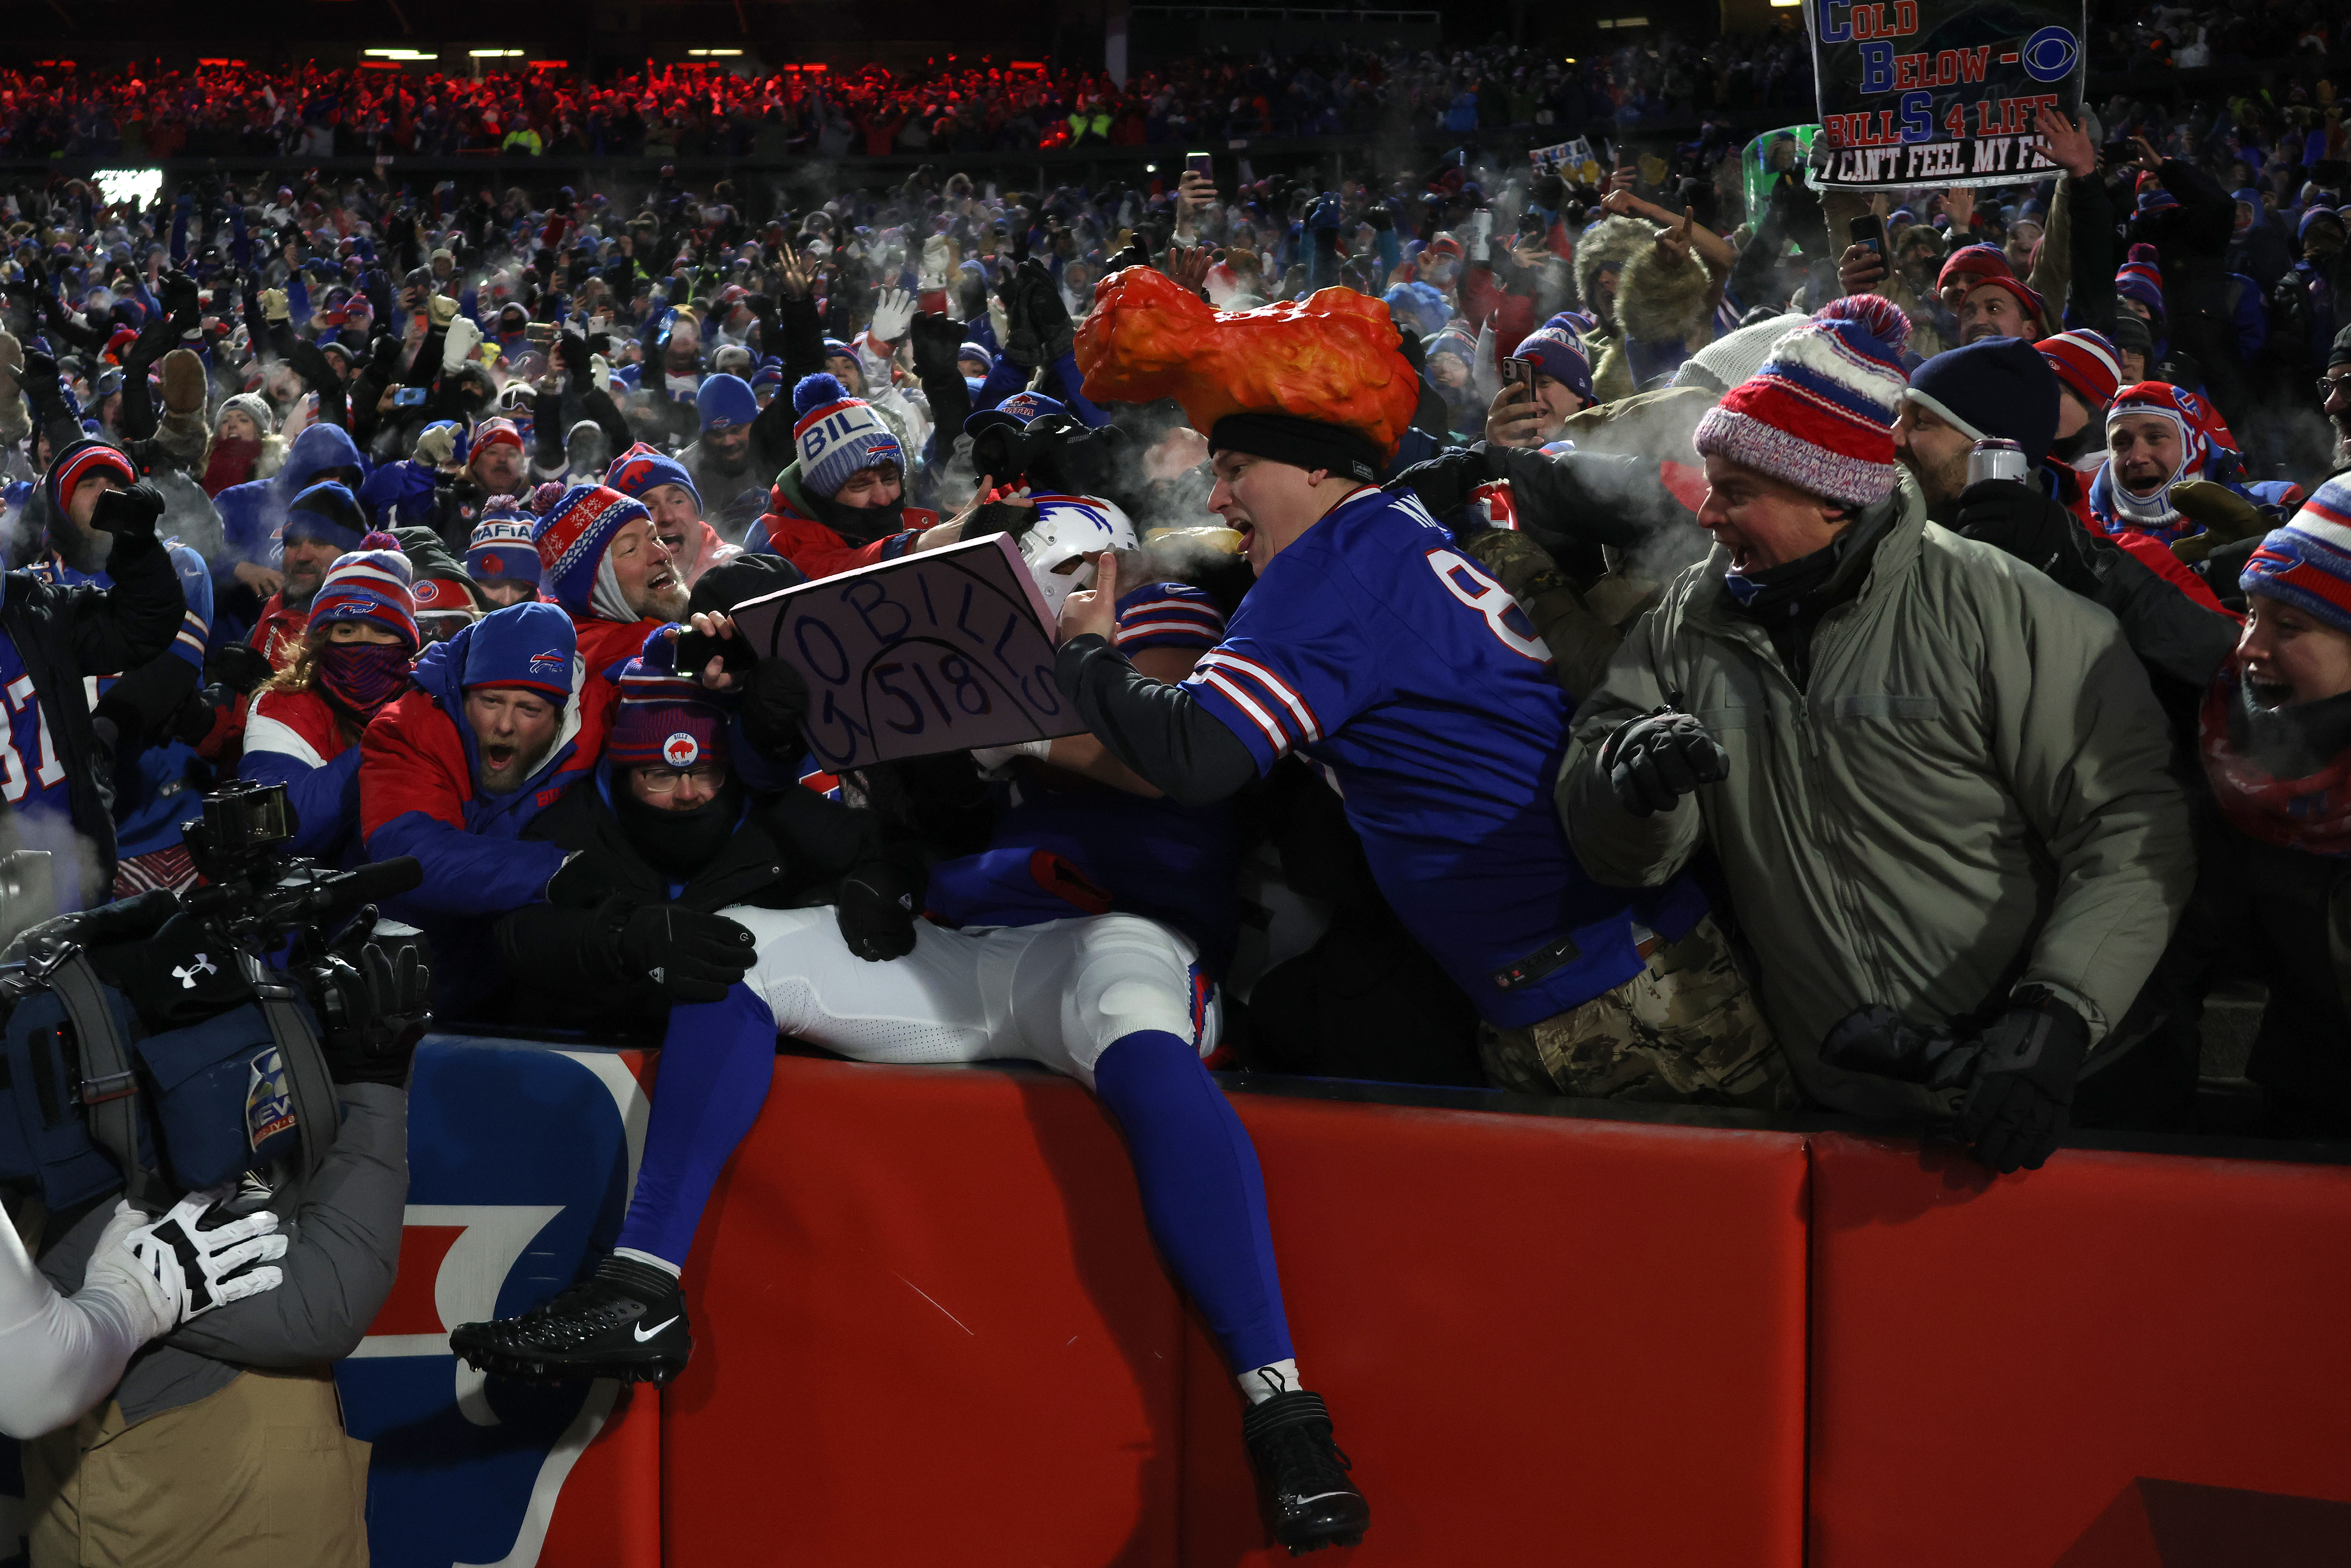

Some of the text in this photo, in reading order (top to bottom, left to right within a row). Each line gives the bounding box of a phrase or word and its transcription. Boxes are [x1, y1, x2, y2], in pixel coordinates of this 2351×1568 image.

[1819, 0, 1918, 43] COLD
[1859, 41, 1990, 94] BELOW
[1824, 91, 1932, 148] BILLS
[1945, 103, 1965, 139] 4
[1820, 151, 1835, 180] I
[1837, 146, 1900, 181] CAN'T
[1905, 142, 1965, 178] FEEL
[1972, 137, 2012, 173] MY
[872, 653, 992, 735] 518
